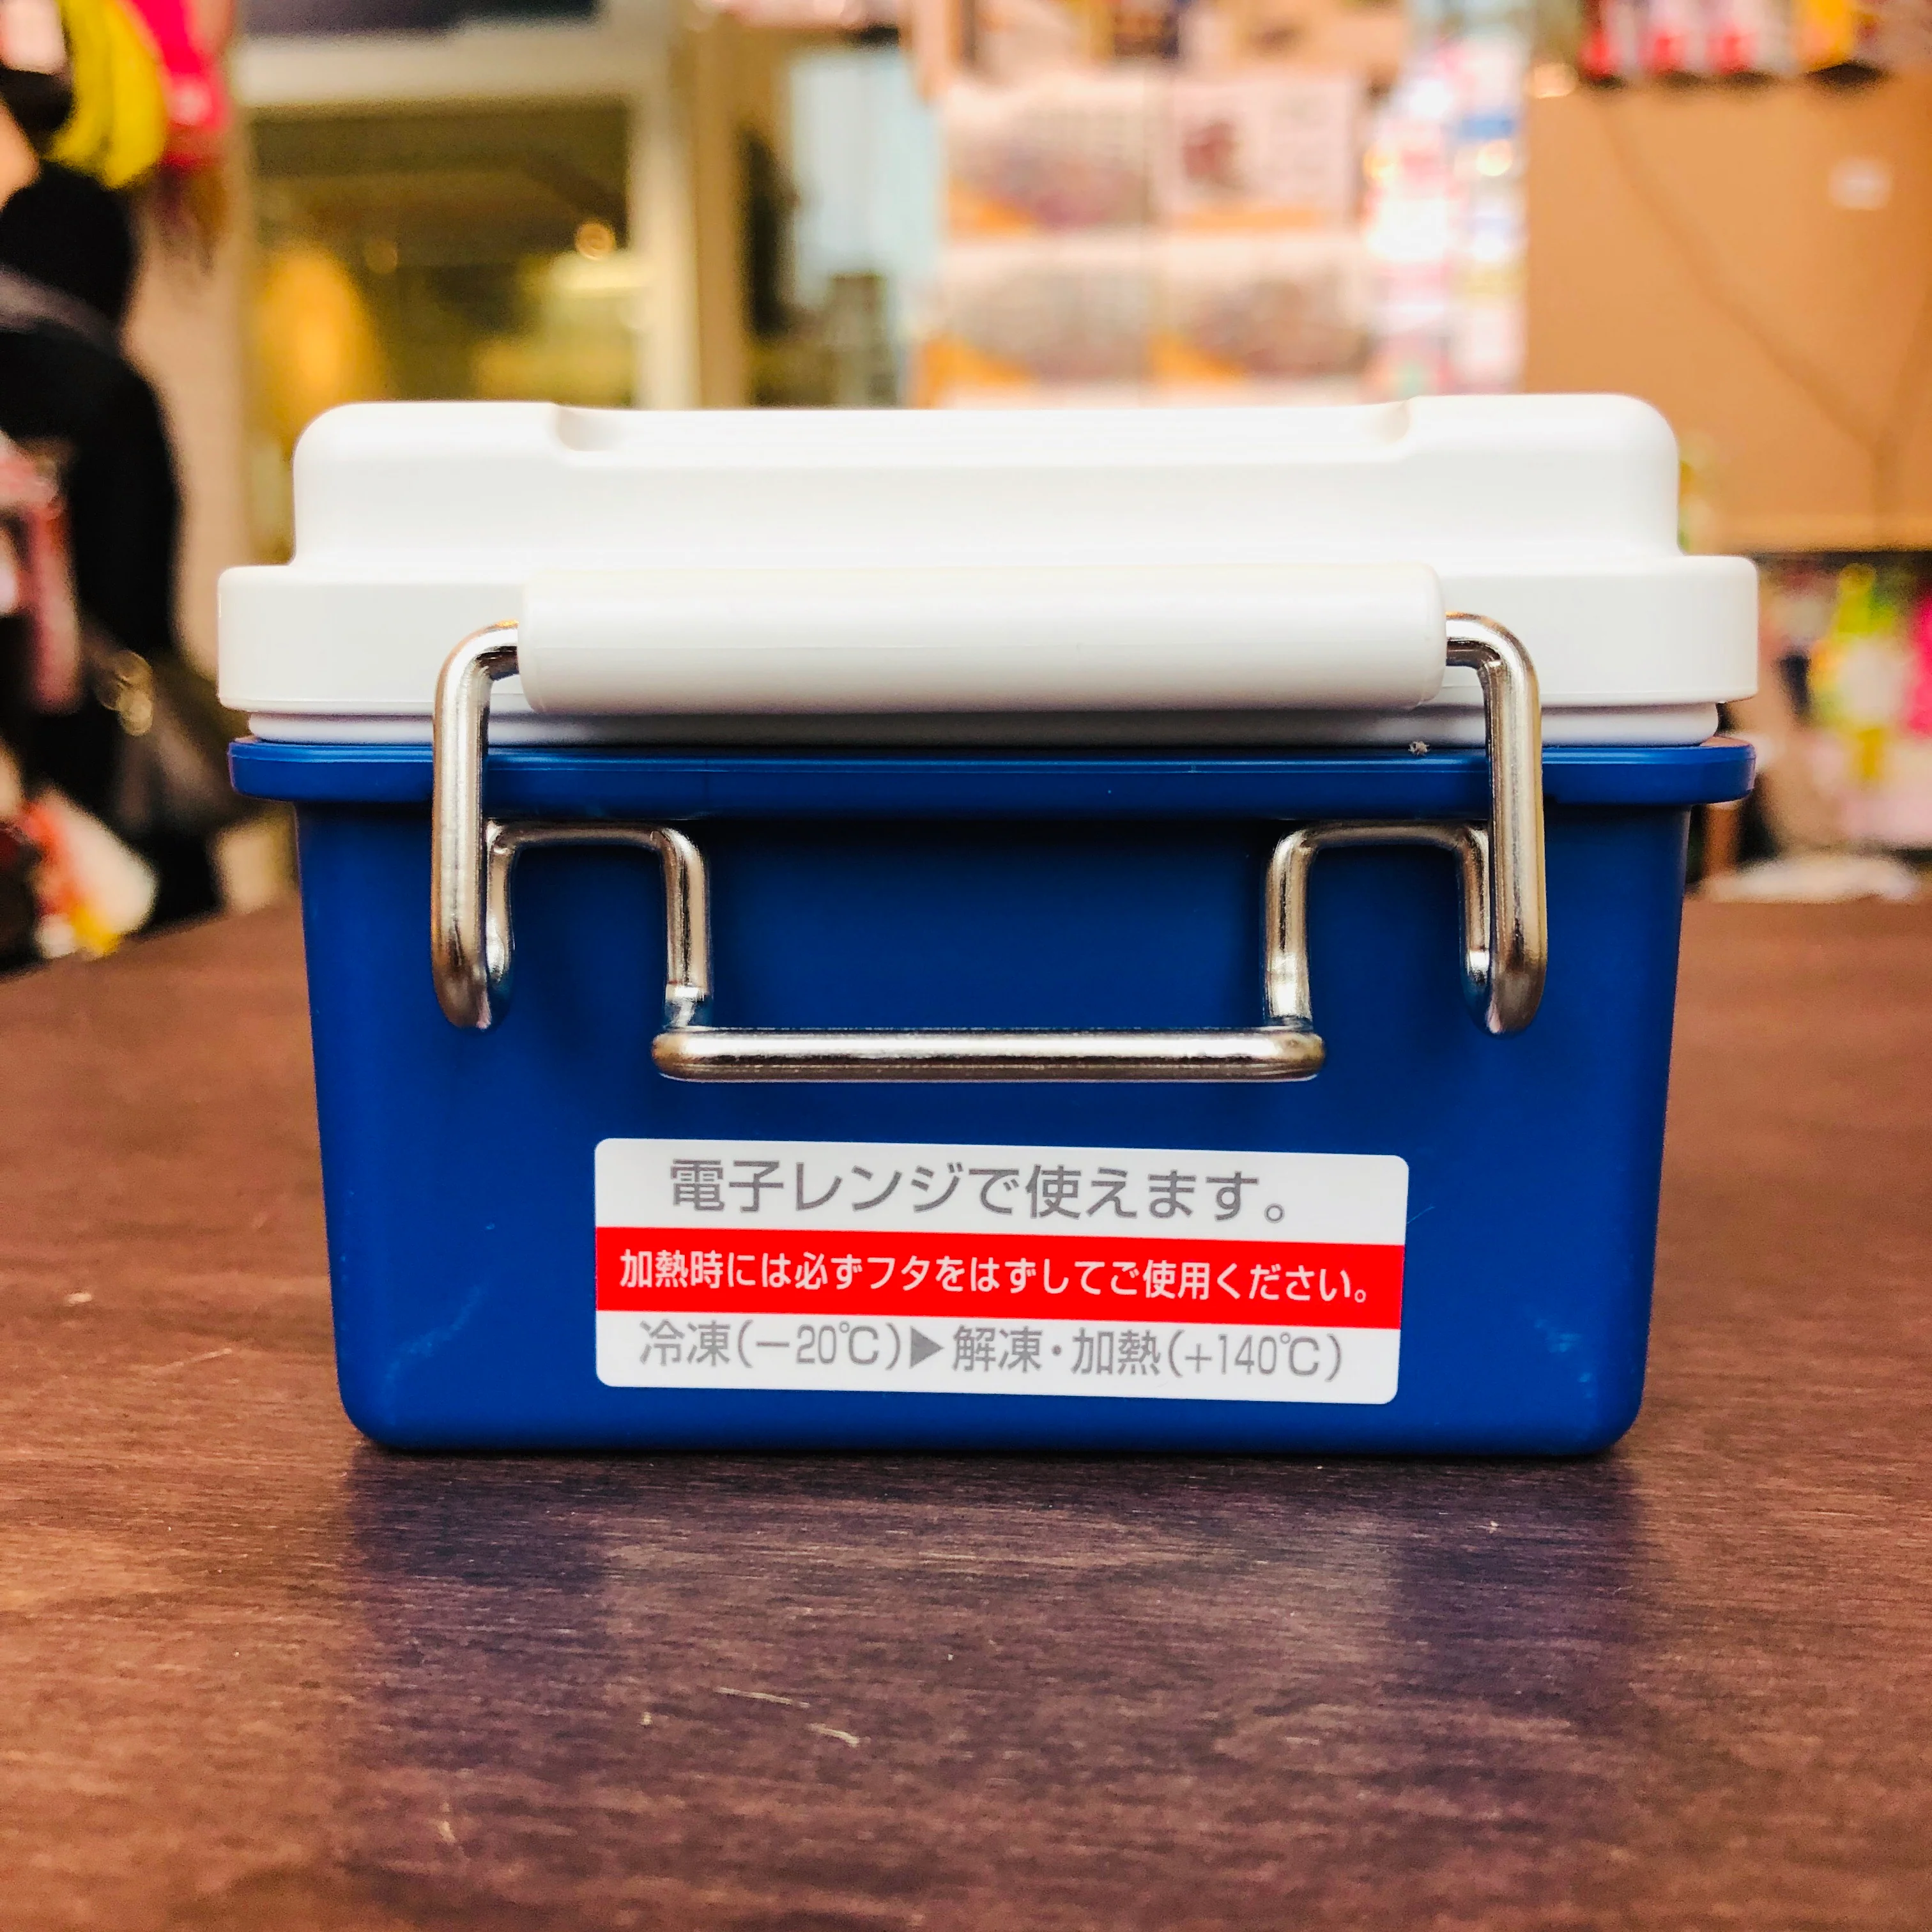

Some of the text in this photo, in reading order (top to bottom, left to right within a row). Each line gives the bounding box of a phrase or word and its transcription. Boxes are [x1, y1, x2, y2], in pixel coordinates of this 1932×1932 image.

[670, 1158, 1285, 1224] 電子レンジで使えます。
[620, 1248, 1367, 1303] 加熱時には必ずフタをはずしてご使用ください。
